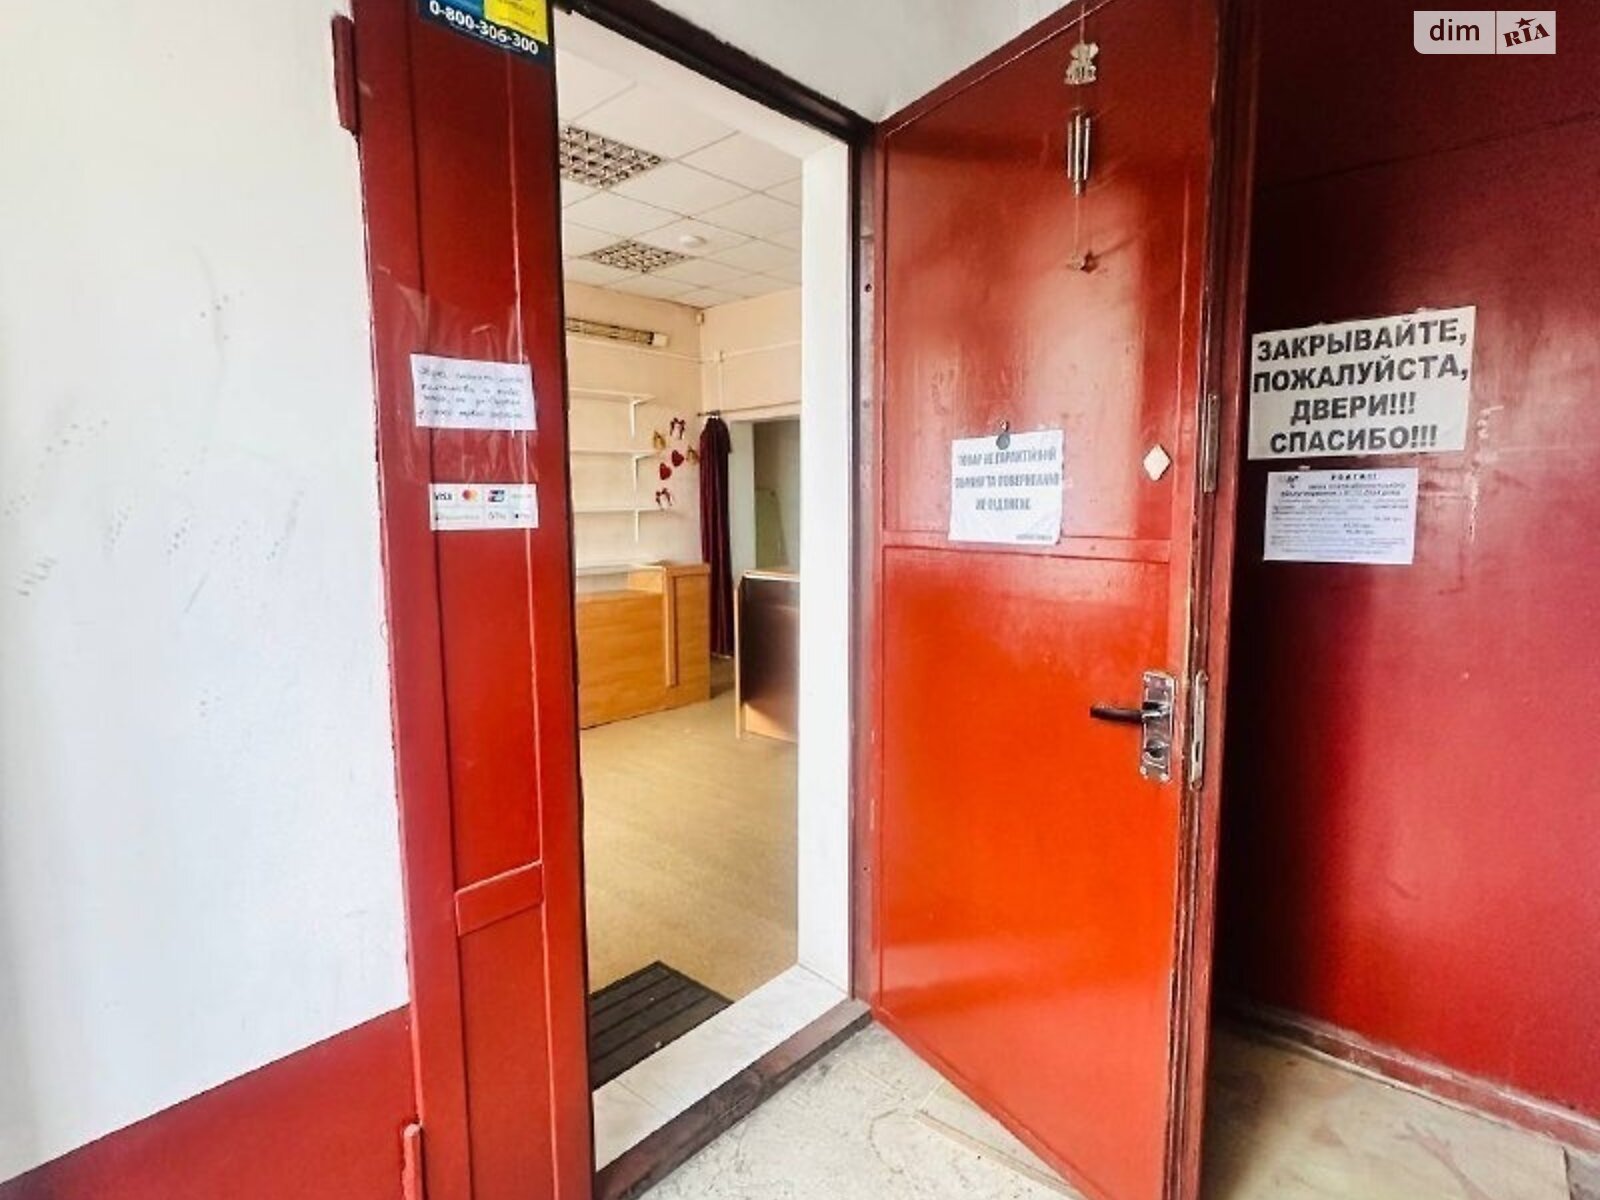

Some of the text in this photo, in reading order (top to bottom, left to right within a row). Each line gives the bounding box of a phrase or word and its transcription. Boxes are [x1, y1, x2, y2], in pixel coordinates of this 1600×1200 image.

[429, 0, 539, 55] 0-800-306-300
[1256, 318, 1467, 361] ЗАКРЫВАЙТЕ,
[1253, 353, 1469, 393] ПОЖАЛУЙСТА,
[1290, 391, 1417, 425] ДВЕРИ!!!
[1270, 424, 1437, 453] СПАСИБО!!!
